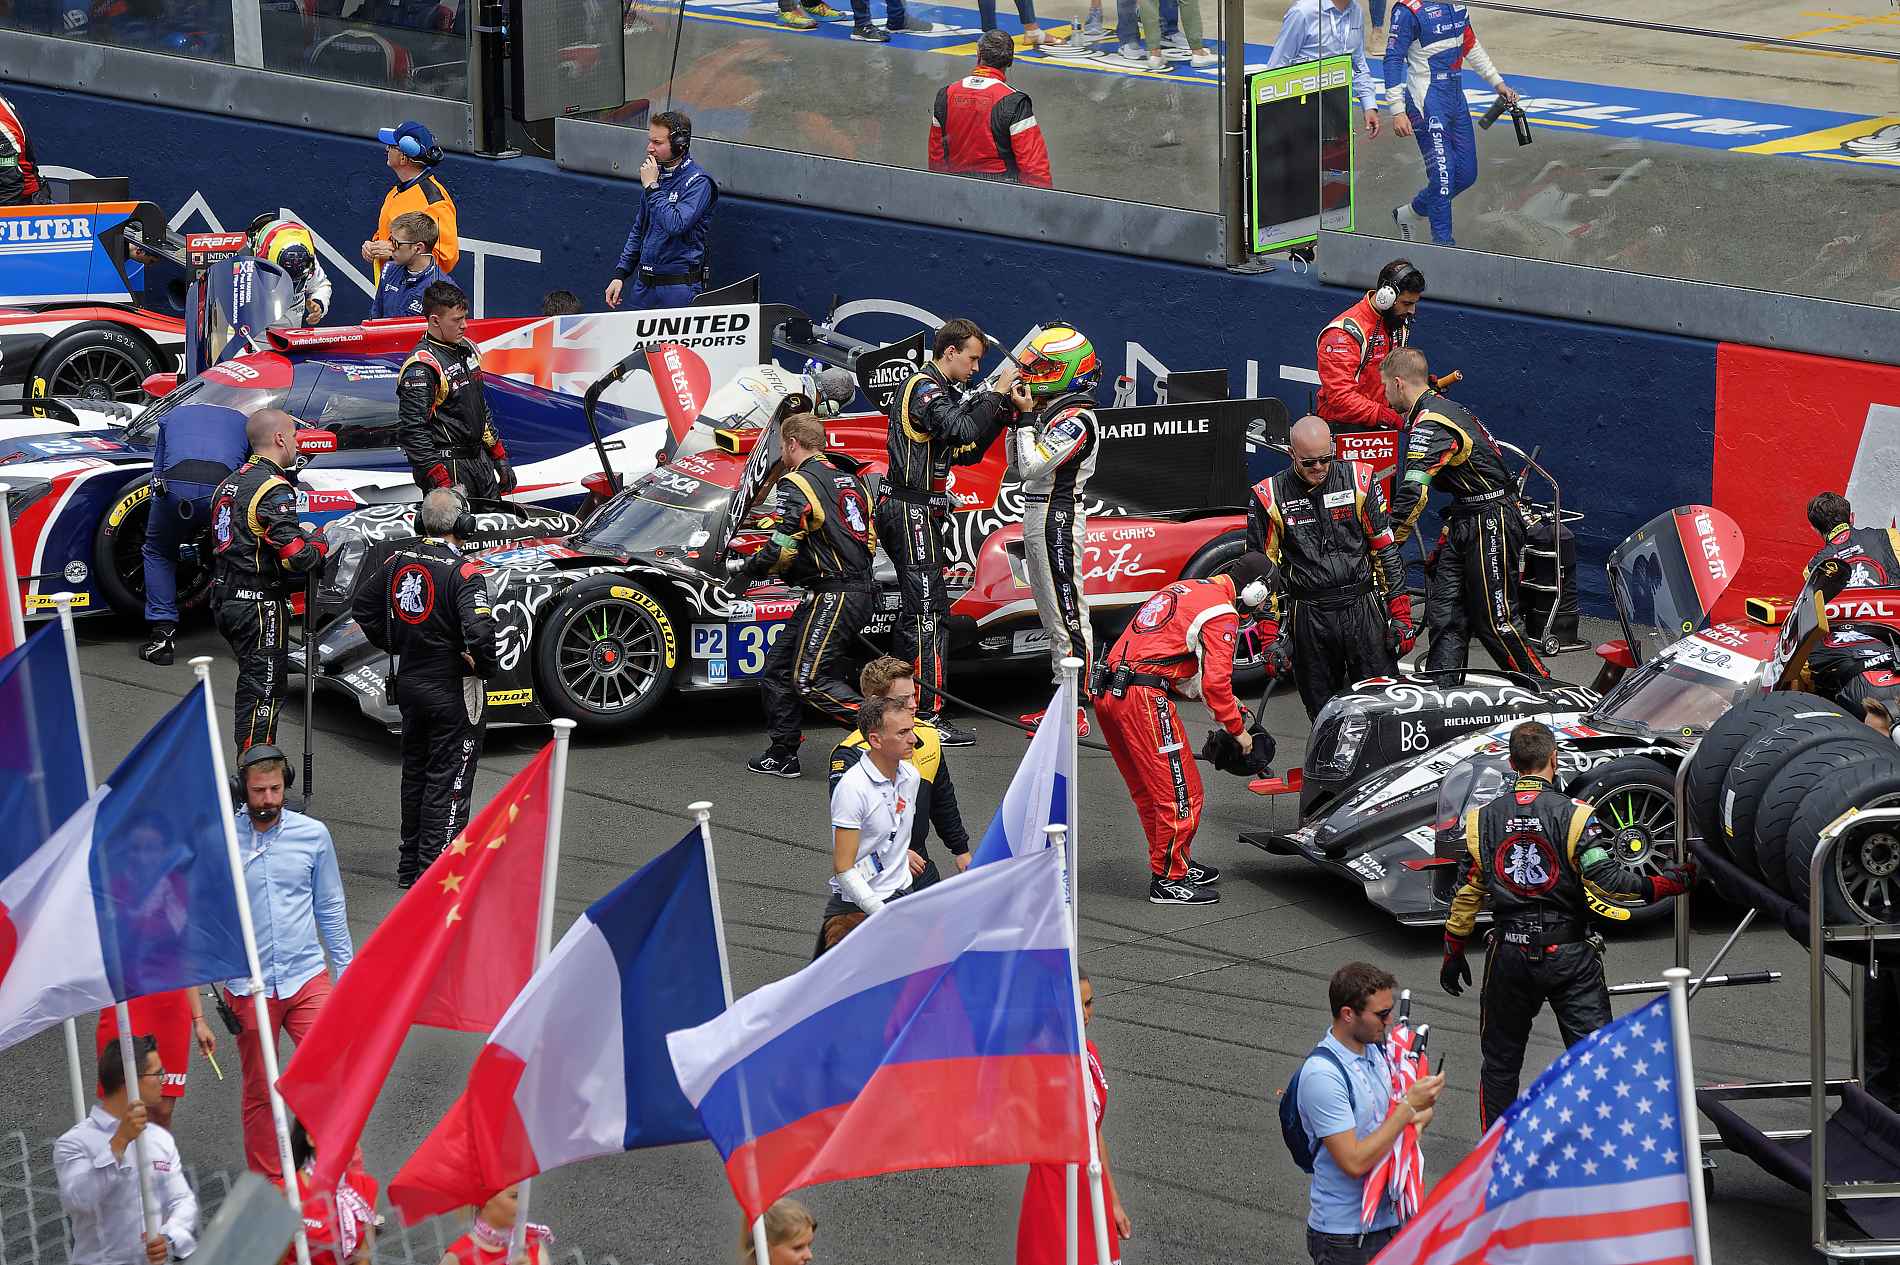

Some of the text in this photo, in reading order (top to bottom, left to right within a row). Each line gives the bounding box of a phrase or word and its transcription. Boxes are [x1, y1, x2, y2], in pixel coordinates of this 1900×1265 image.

[1260, 68, 1346, 99] eurasia
[1432, 132, 1449, 195] SMP RACING
[190, 236, 243, 248] GRAFF
[635, 313, 751, 337] UNITED
[292, 334, 363, 346] unitedautosports.com
[1153, 418, 1210, 435] MILLE
[1342, 437, 1394, 447] TOTAL
[1342, 448, 1394, 460] 道达尔
[1695, 513, 1728, 580] 道达尔
[631, 591, 675, 659] DUNLOP
[694, 629, 723, 654] P2
[1444, 713, 1525, 727] RICHARD MILLE
[1358, 852, 1389, 877] TOTAL
